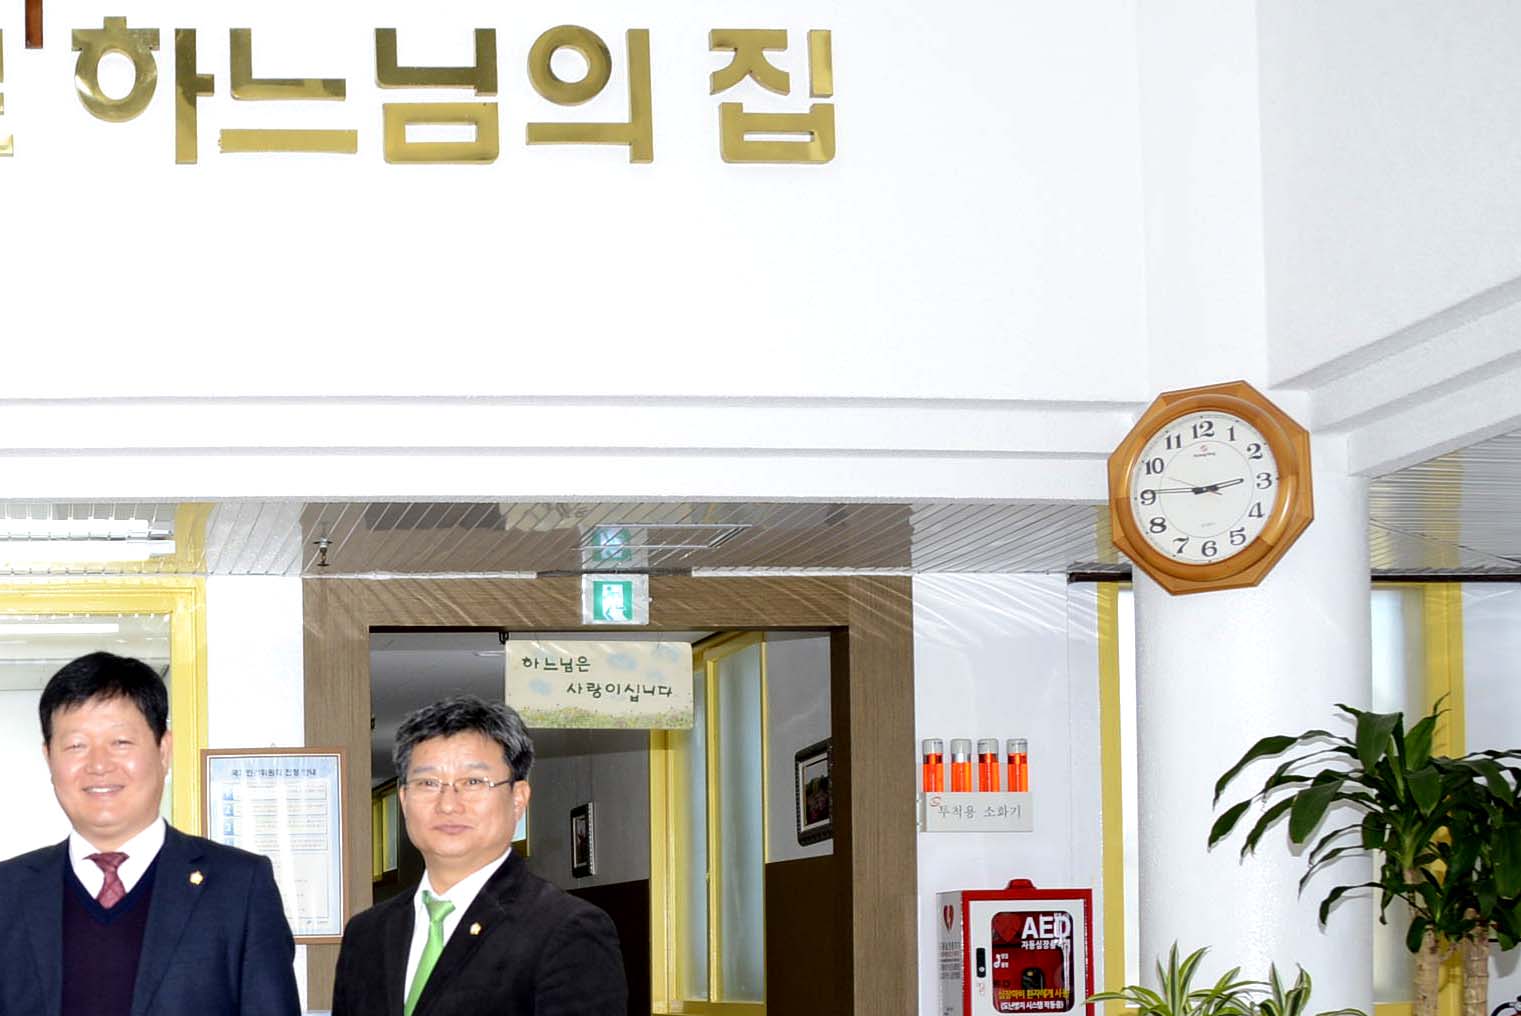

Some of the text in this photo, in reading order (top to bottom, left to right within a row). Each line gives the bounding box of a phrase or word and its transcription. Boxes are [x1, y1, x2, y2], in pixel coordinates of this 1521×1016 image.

[71, 17, 655, 164] 하느님의
[708, 28, 837, 163] 집
[1192, 420, 1215, 440] 12
[1227, 427, 1236, 441] 1
[1165, 434, 1182, 450] 11
[1247, 443, 1263, 459] 2
[1145, 457, 1165, 475] 10
[1256, 472, 1273, 489] 3
[1140, 489, 1157, 506] 9
[1248, 502, 1265, 518] 4
[1150, 516, 1167, 534] 8
[1230, 527, 1246, 546] 5
[1173, 537, 1189, 554] 7
[1201, 540, 1218, 557] 6
[522, 655, 591, 673] 하느님은
[566, 682, 673, 703] 사랑이십니다
[983, 803, 1022, 819] 소화기
[1021, 913, 1071, 940] AED
